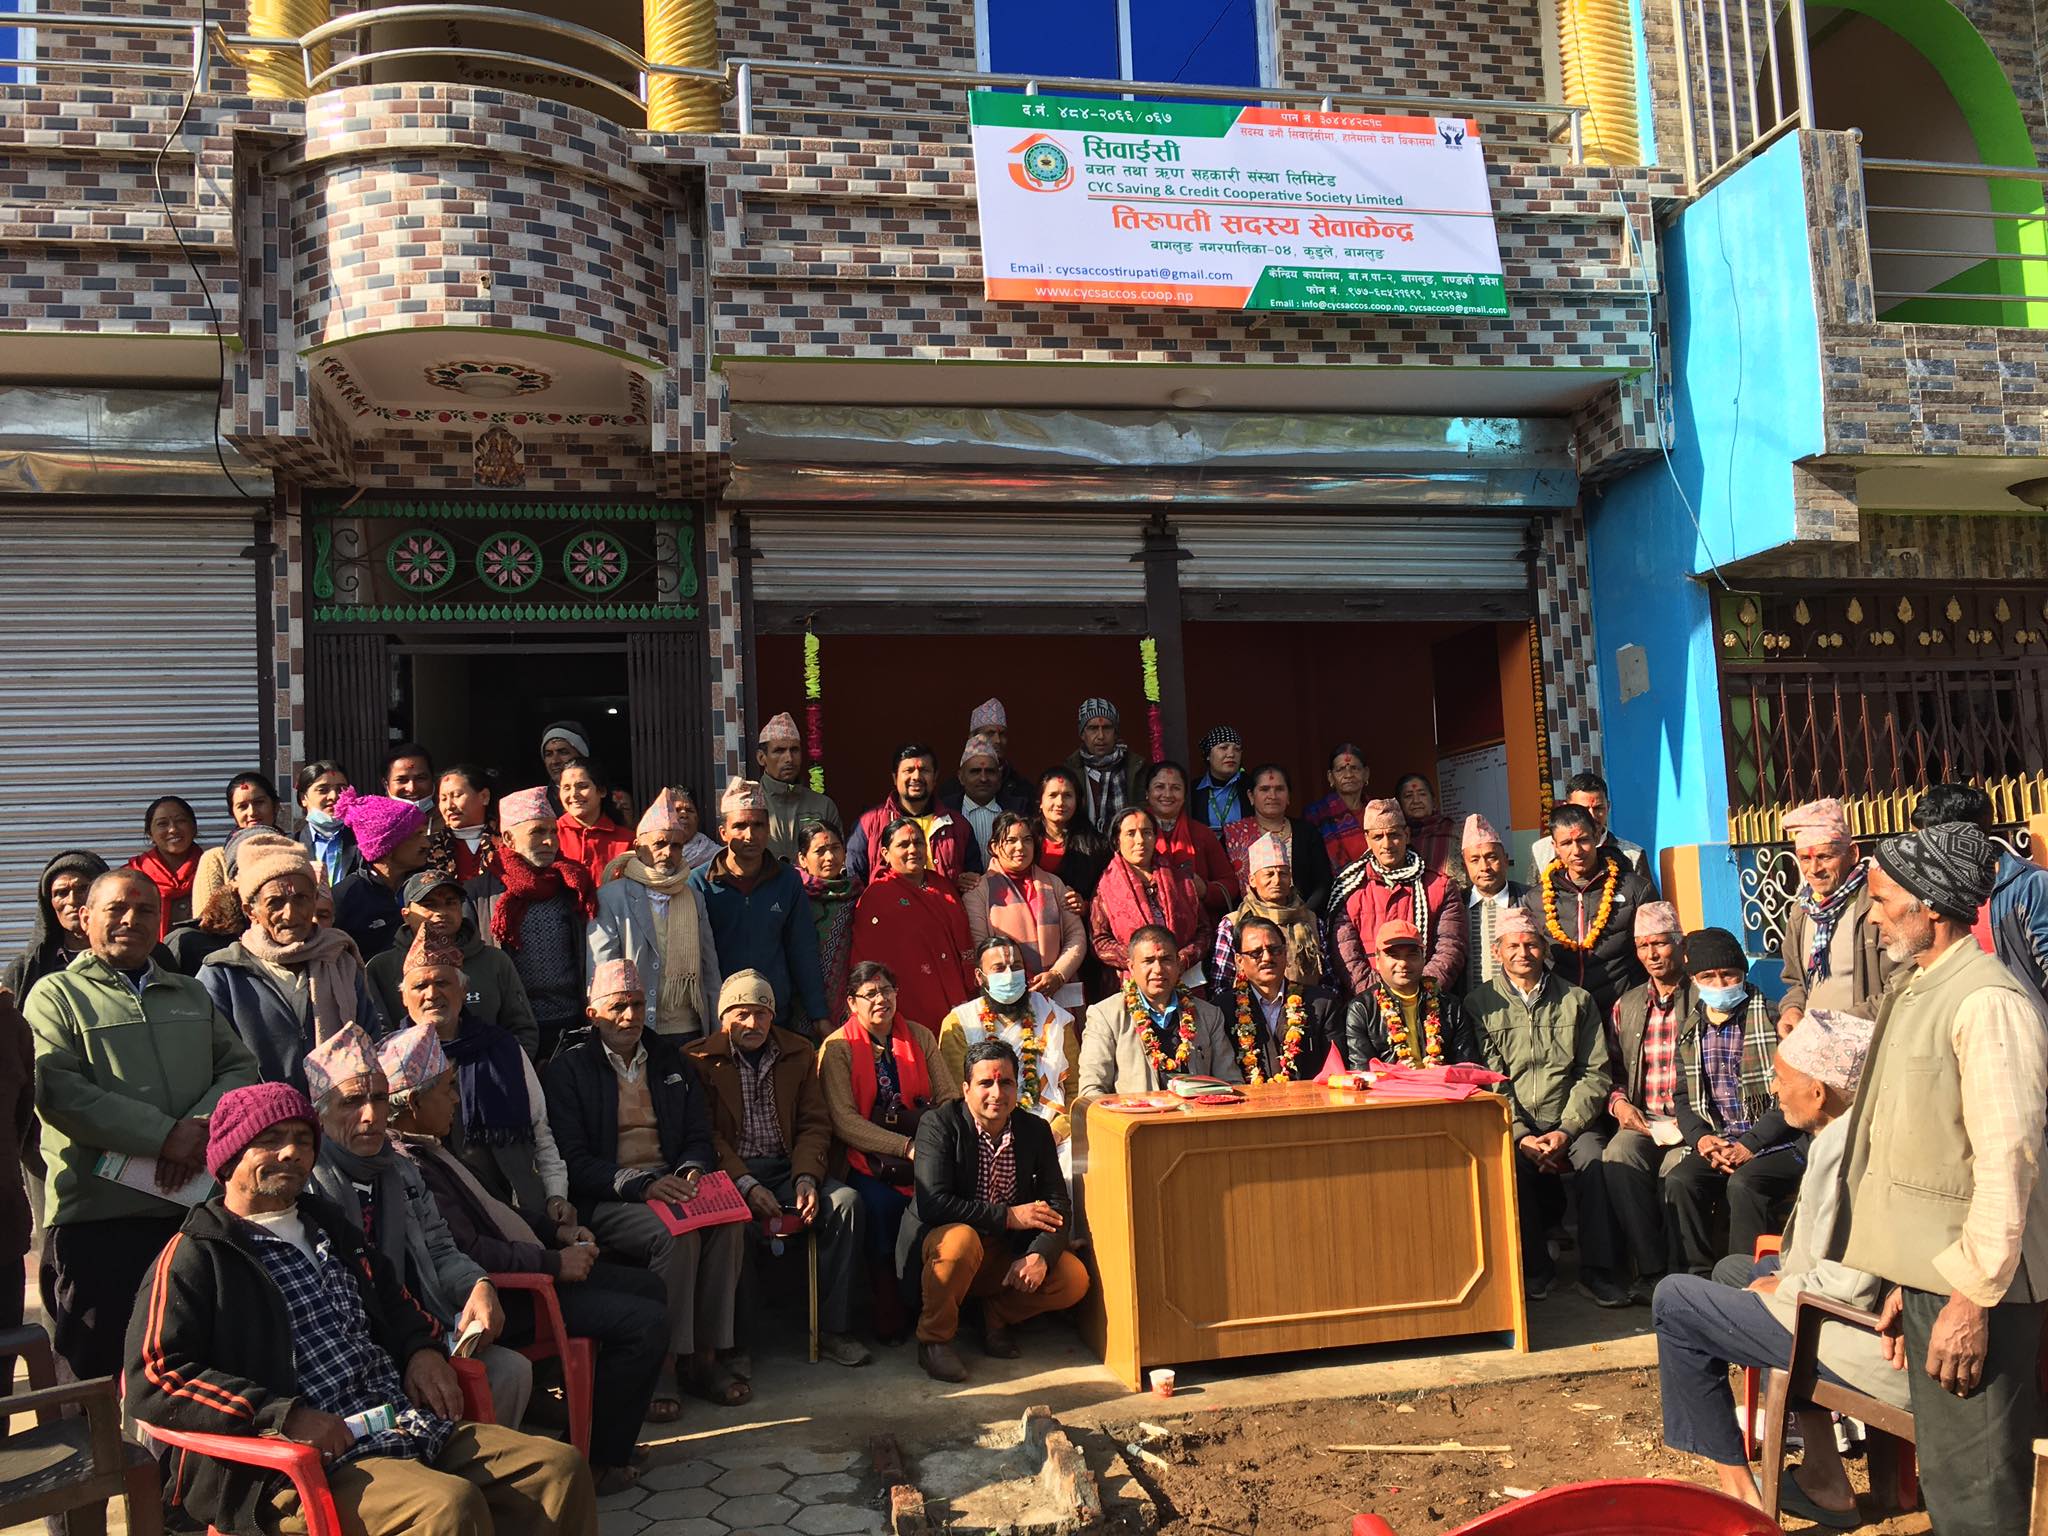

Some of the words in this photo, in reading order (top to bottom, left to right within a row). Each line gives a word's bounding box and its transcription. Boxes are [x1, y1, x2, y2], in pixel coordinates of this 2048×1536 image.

[1280, 113, 1299, 122] पान
[1083, 135, 1181, 163] सिवाईसी
[1085, 164, 1116, 176] बचत
[1122, 166, 1148, 177] तथा
[1154, 167, 1184, 179] ऋण
[1191, 167, 1240, 184] सहकारी
[1247, 170, 1280, 184] संस्था
[1286, 170, 1336, 187] लिमिटेड
[1088, 181, 1113, 193] CYC
[1117, 182, 1161, 197] Saving
[1165, 185, 1175, 196] &
[1180, 186, 1219, 198] Credit
[1224, 187, 1302, 202] Cooperative
[1306, 191, 1351, 206] Society
[1356, 194, 1403, 206] Limited
[1220, 215, 1300, 236] सदस्य
[1308, 213, 1414, 242] सेवाकेन्द्र
[1010, 263, 1044, 274] Email
[1055, 266, 1233, 281] cycsaccostirupati@gmail.com
[1034, 286, 1193, 303] www.cycsaccos.coop.np
[1306, 284, 1326, 295] फोन
[1270, 299, 1294, 308] Email
[1301, 299, 1407, 313] info@cycsaccos.coop.np,
[1409, 304, 1507, 315] cycsaccos9@gmail.com
